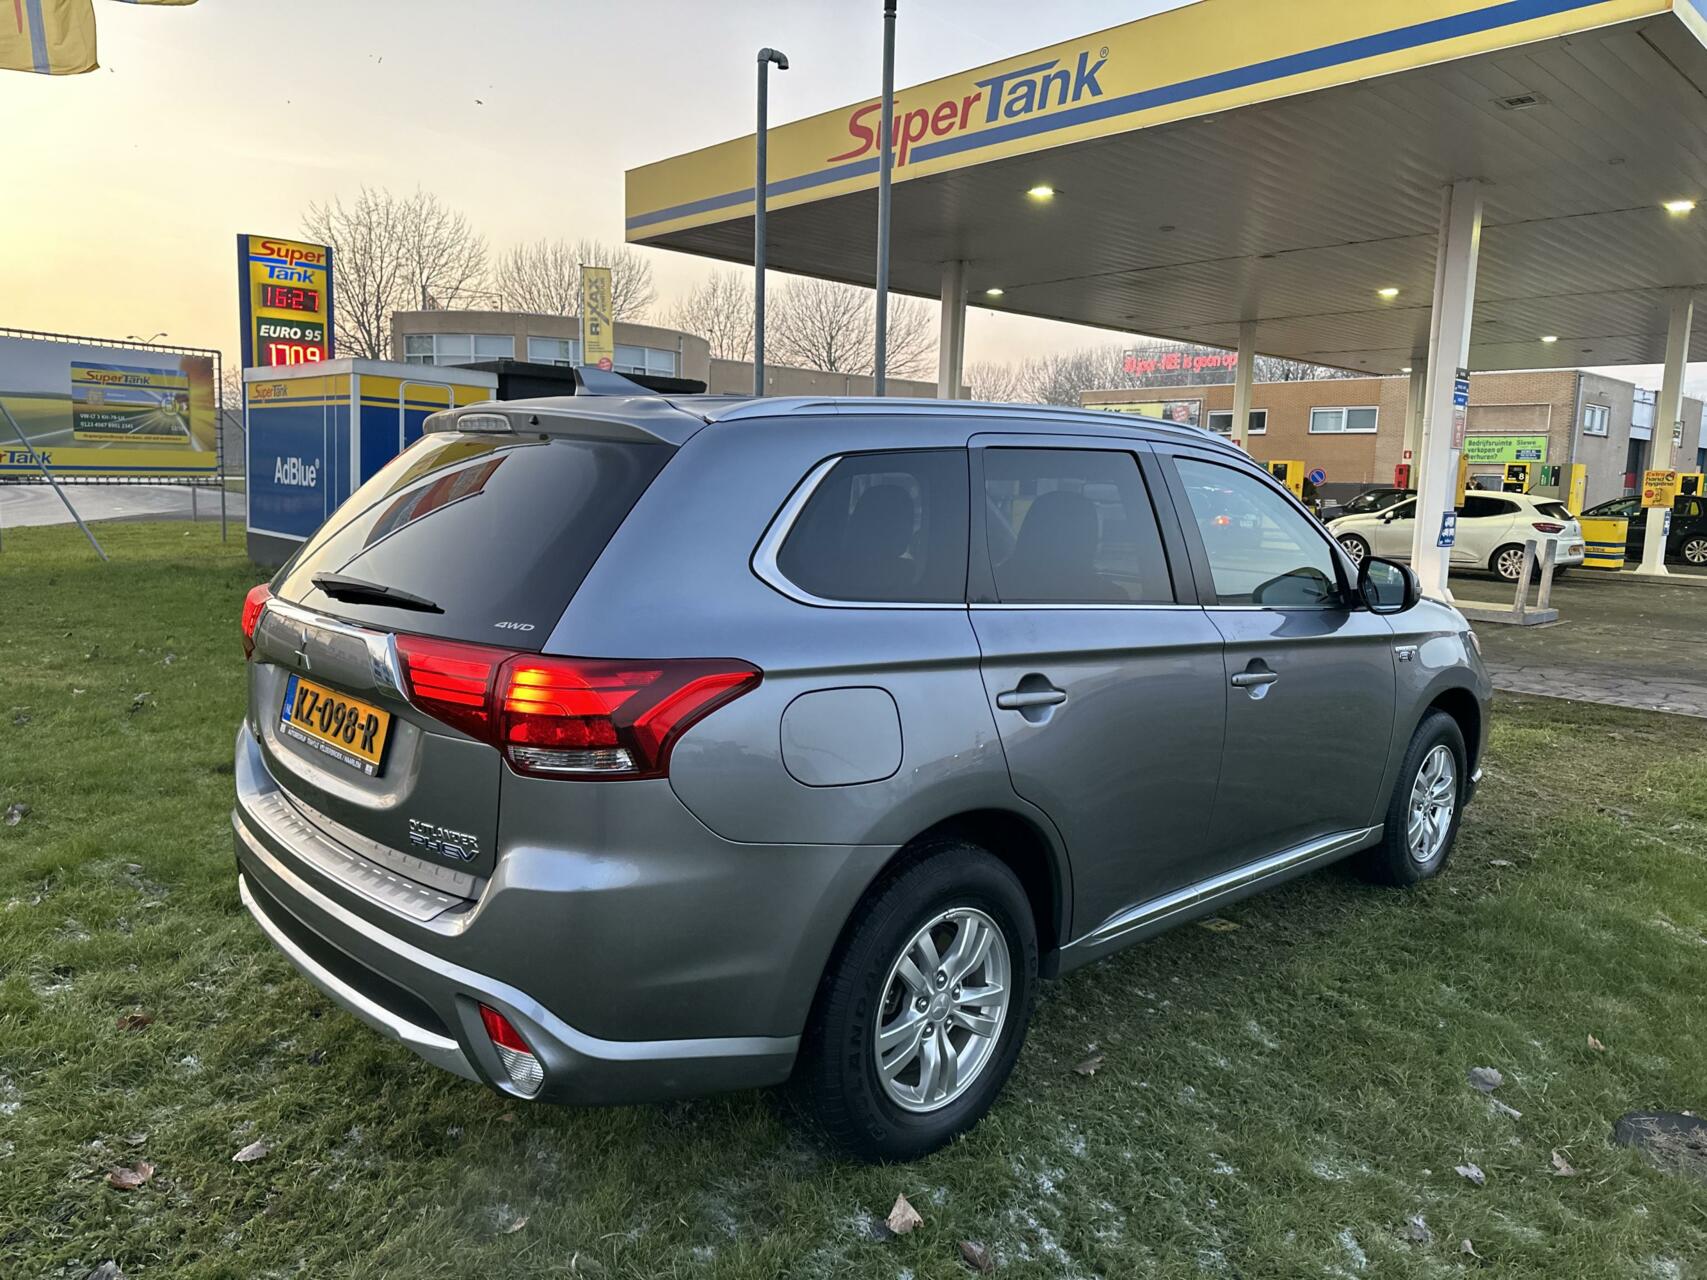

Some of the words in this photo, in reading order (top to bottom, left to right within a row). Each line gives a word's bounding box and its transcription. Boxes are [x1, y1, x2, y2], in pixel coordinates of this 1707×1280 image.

[249, 240, 325, 266] Super
[263, 264, 315, 284] Tank
[267, 287, 320, 312] 16:27
[260, 325, 302, 340] EURO
[304, 330, 323, 341] 95
[86, 370, 151, 385] SuperTank
[274, 456, 316, 487] AdBlue
[494, 621, 535, 631] 4WD
